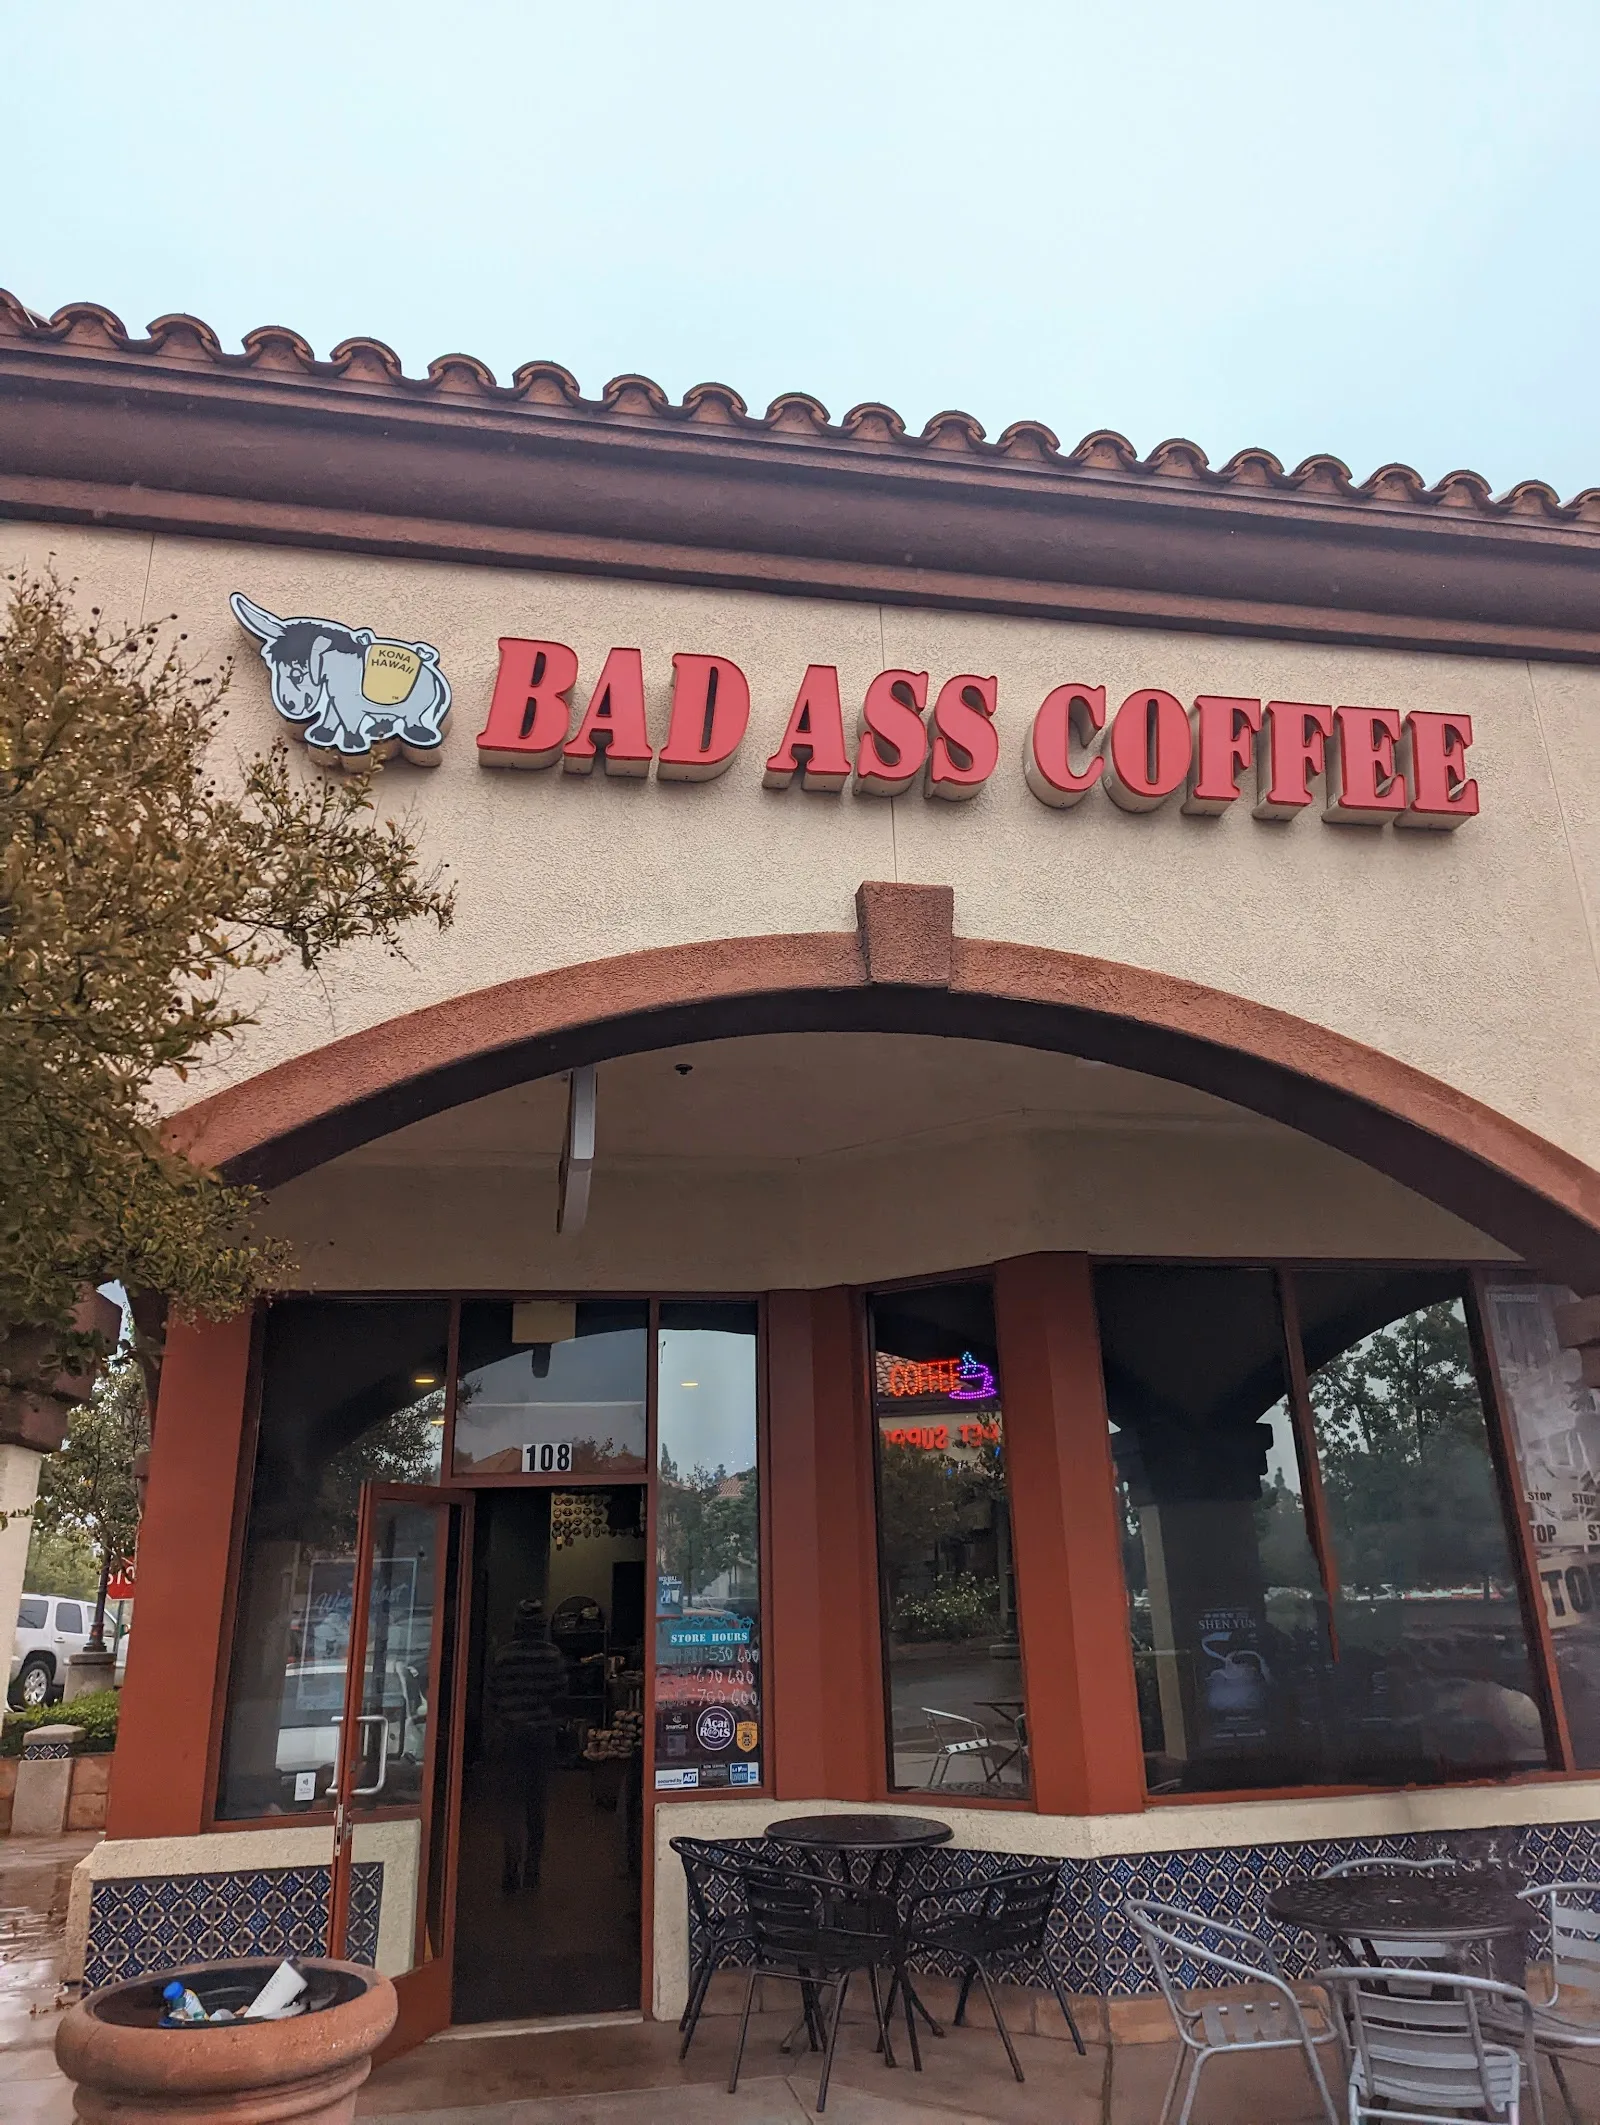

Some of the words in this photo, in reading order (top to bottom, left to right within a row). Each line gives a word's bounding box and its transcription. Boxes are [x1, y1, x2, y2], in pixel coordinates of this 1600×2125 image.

[379, 650, 411, 663] KONA
[371, 659, 414, 674] HAWAII
[476, 637, 751, 767] BAD
[766, 664, 1000, 785] ASS
[1031, 683, 1481, 816] COFFEE
[890, 1360, 962, 1397] COFFEE
[526, 1443, 570, 1471] 108
[1528, 1491, 1552, 1501] STOP
[1572, 1493, 1597, 1506] STOP
[1531, 1524, 1557, 1543] TOP
[1199, 1619, 1230, 1629] SHEN
[671, 1634, 706, 1643] STORE
[711, 1632, 748, 1642] HOURS
[683, 1773, 697, 1783] ADT
